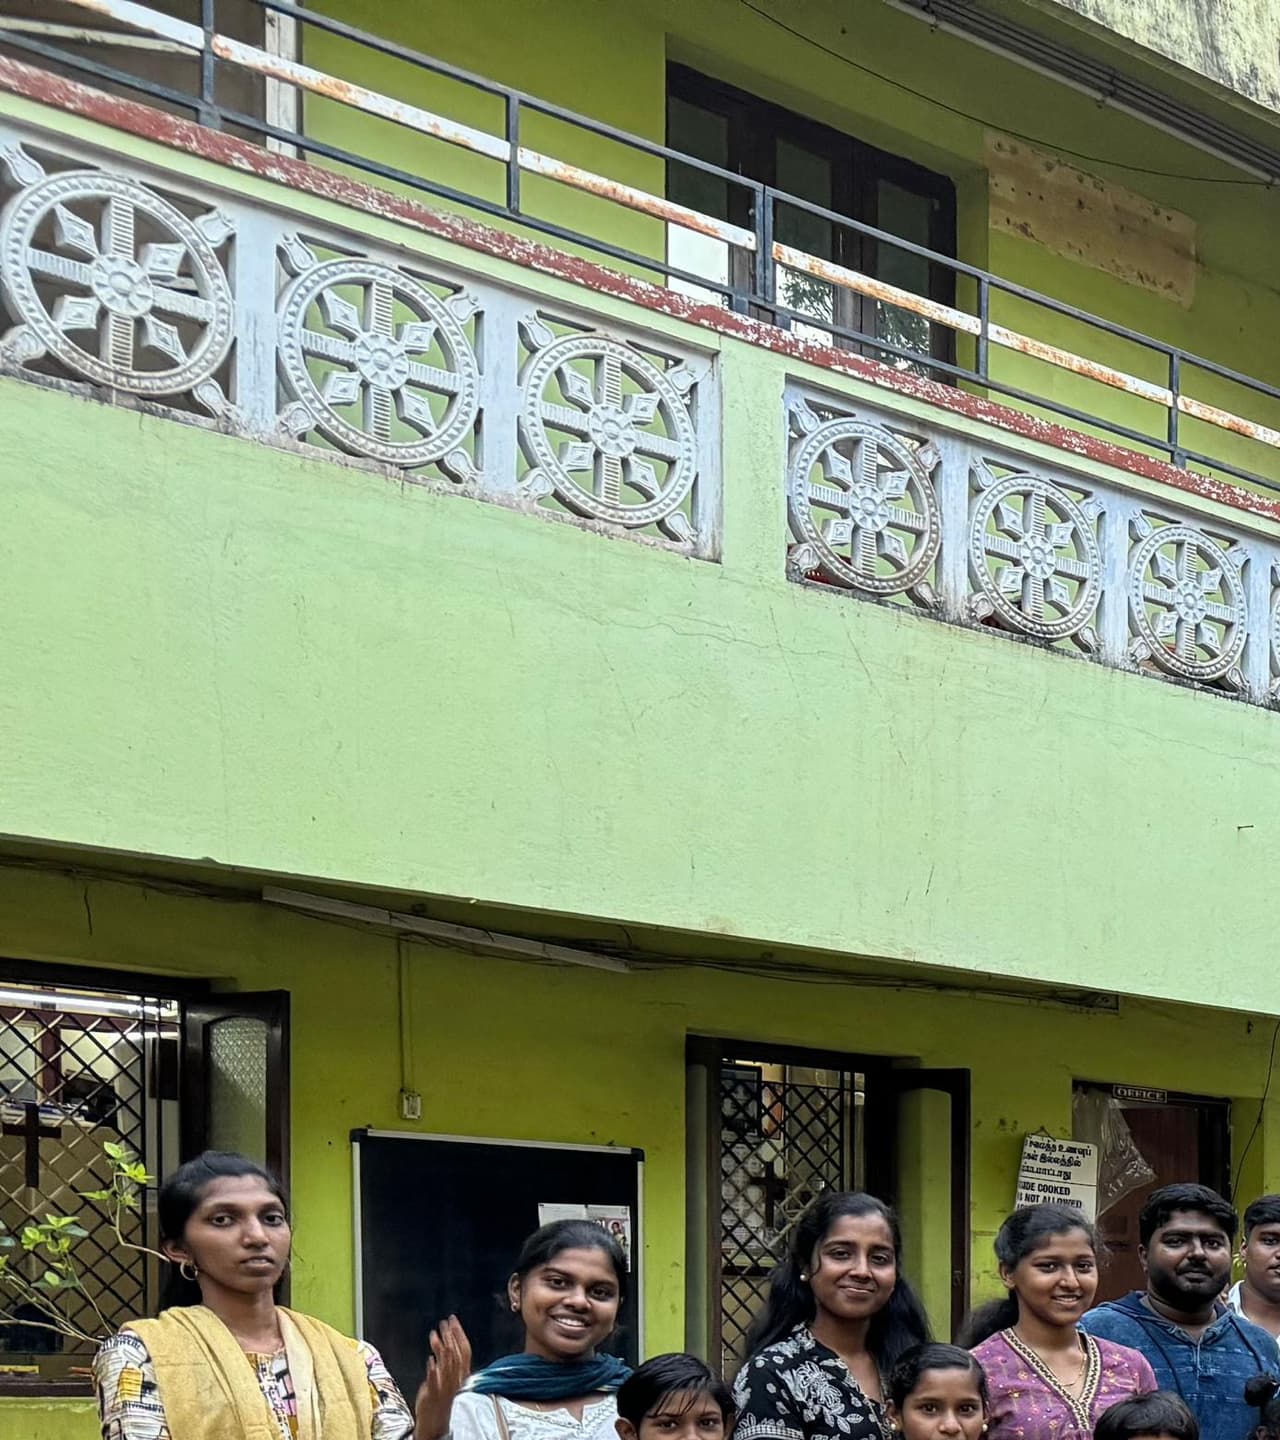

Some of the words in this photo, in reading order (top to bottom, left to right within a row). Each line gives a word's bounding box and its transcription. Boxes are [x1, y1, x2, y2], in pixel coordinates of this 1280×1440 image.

[1117, 1088, 1163, 1100] OFFICE
[1038, 1183, 1071, 1196] COOKED
[1025, 1193, 1041, 1203] NOT
